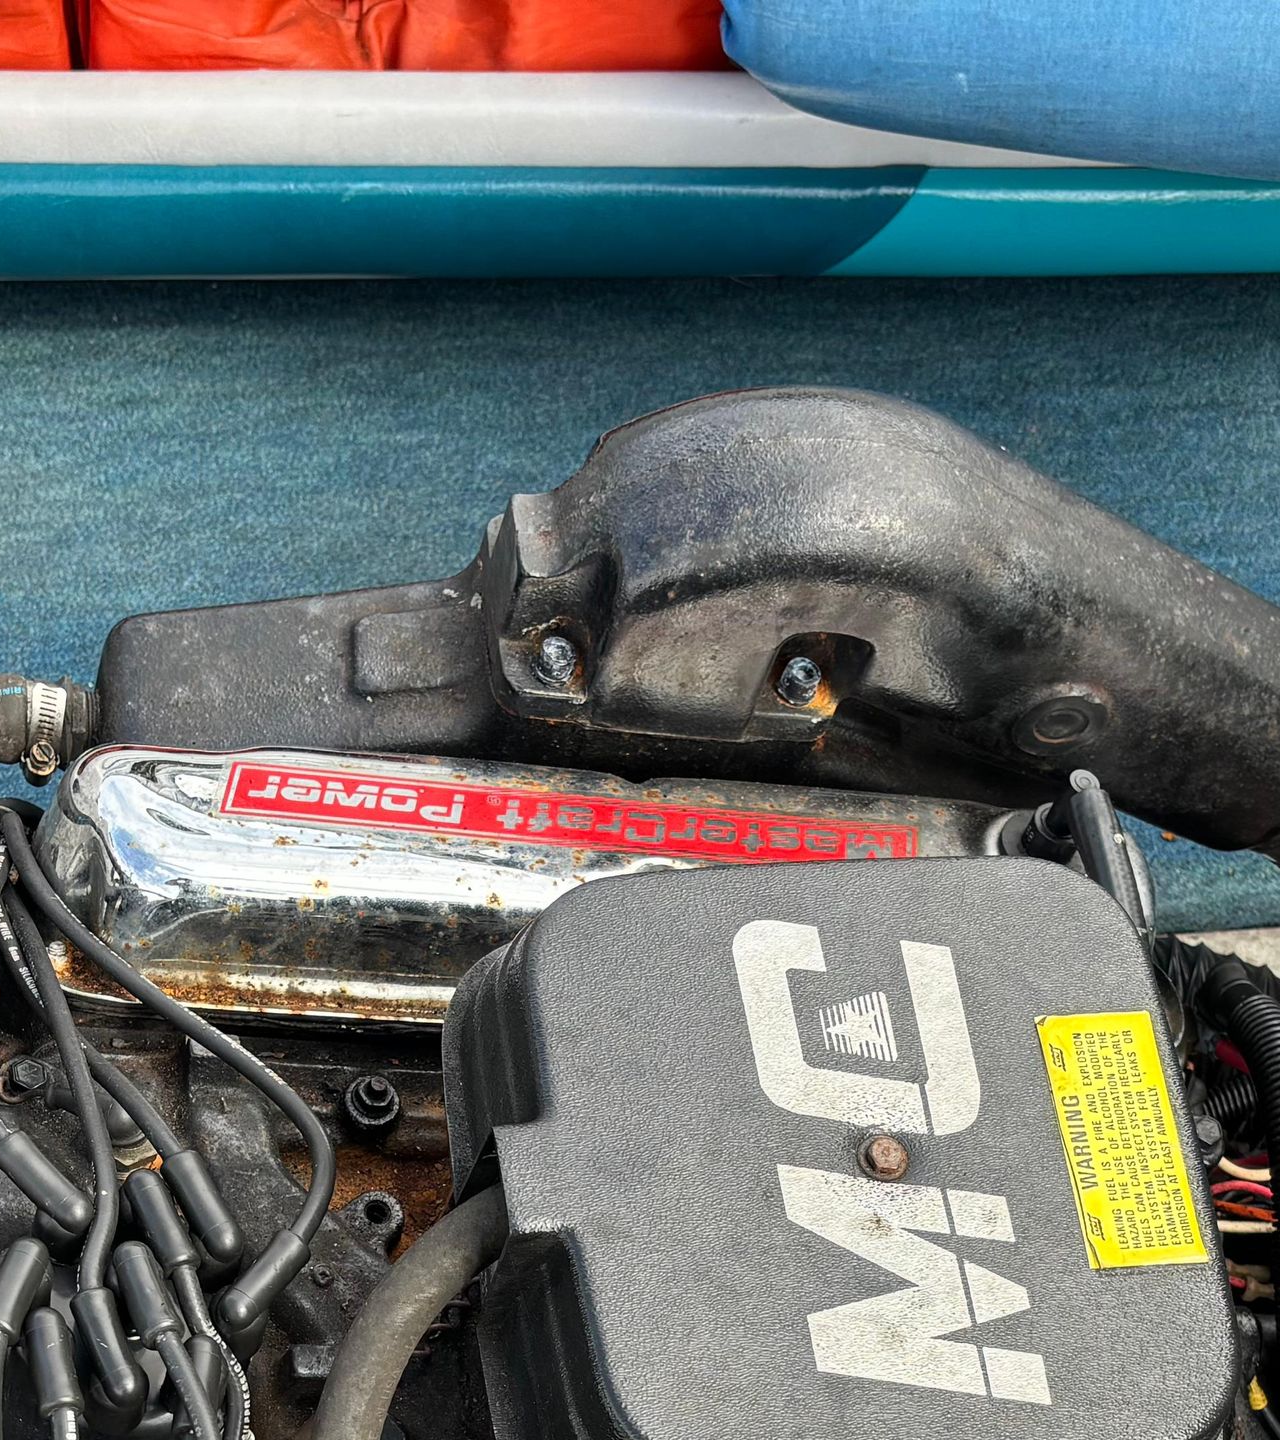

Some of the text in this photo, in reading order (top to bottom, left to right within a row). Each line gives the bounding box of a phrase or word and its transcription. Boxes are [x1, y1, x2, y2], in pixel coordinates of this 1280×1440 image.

[247, 776, 464, 824] Power
[1072, 1033, 1092, 1086] EXPLOSION
[1085, 1094, 1098, 1113] AND
[1123, 1091, 1140, 1129] SYSTEM
[1062, 1096, 1098, 1189] WARNING
[1085, 1033, 1142, 1248] HAZARD THE USE OF ALCOHOL MODIFIED
[1091, 1121, 1105, 1140] FIRE
[1096, 1032, 1155, 1247] FUELS CAN CAUSE DETERIORATION OF THE
[1122, 1030, 1181, 1245] EXAMINE FUEL SYSTEM FOR LEAKS OR
[1101, 1161, 1112, 1171] IS
[1133, 1134, 1150, 1174] INSPECT
[1159, 1141, 1174, 1169] LEAST
[1105, 1178, 1118, 1201] FUEL
[1167, 1174, 1178, 1184] AT
[1144, 1181, 1161, 1220] SYSTEM
[1172, 1188, 1194, 1244] CORROSION
[1112, 1209, 1130, 1249] LEAKING
[1154, 1224, 1168, 1246] FUEL
